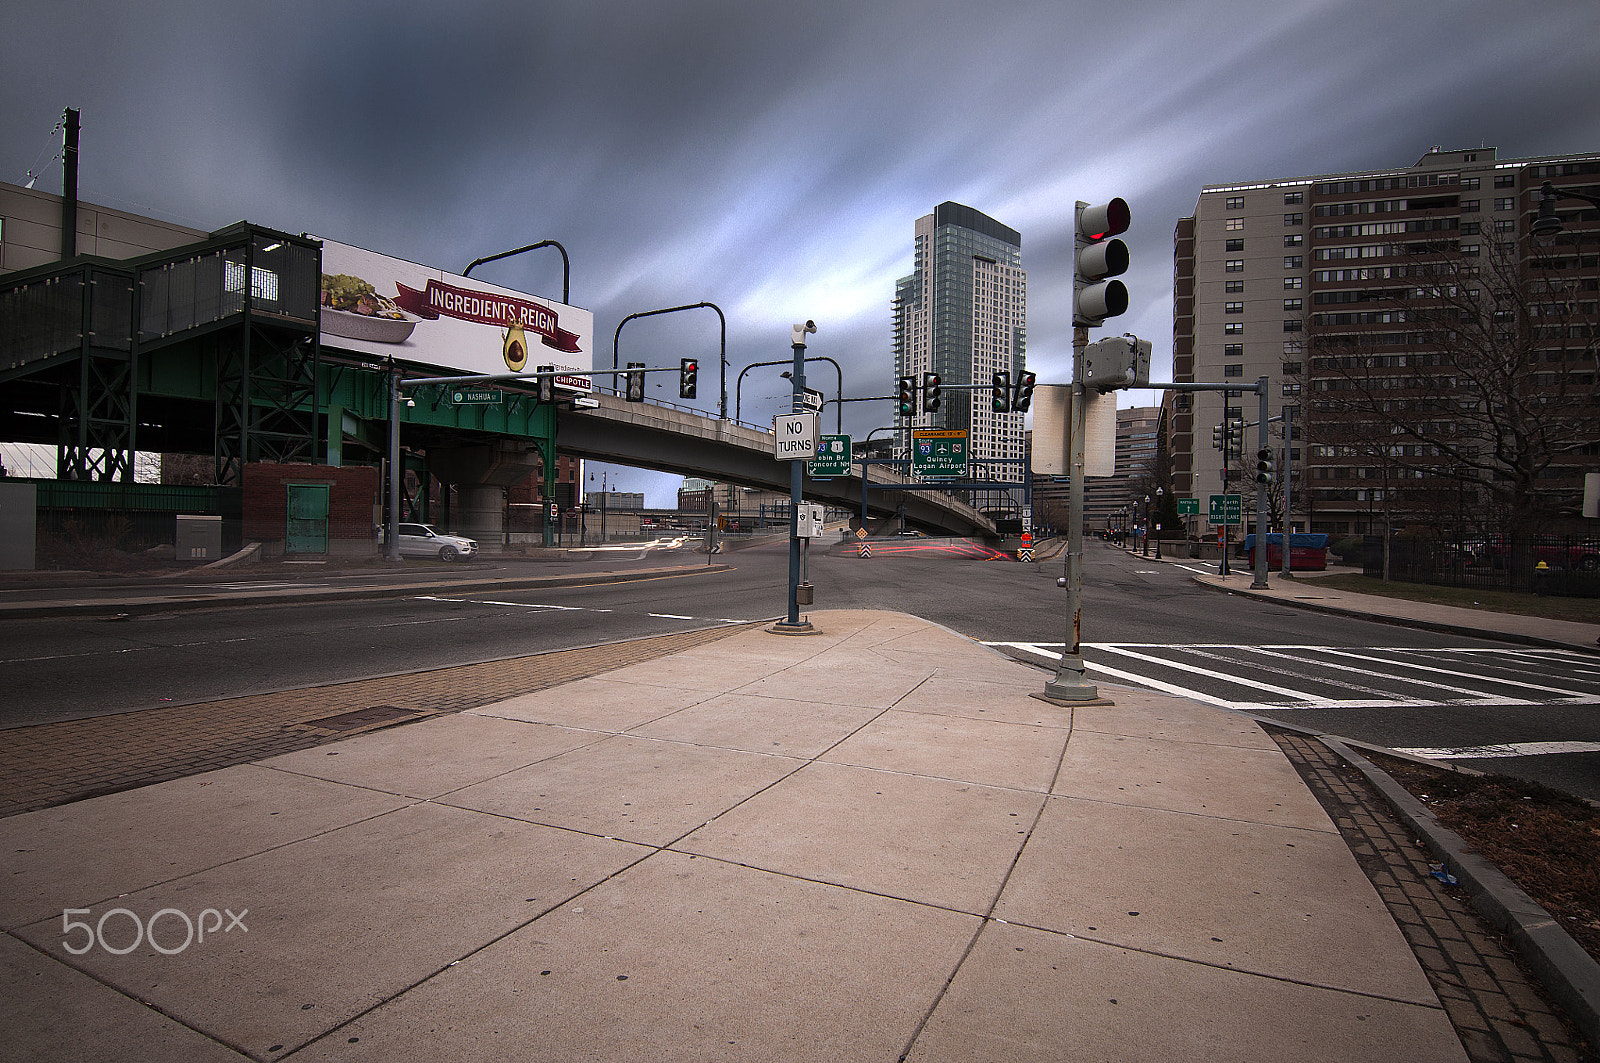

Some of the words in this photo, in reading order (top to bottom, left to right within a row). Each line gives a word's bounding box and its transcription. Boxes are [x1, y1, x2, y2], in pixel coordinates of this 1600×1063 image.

[430, 287, 516, 320] INGREDIENTS
[520, 306, 555, 334] REIGN
[556, 375, 590, 388] CHIPOTLE
[467, 393, 491, 401] NASHUA
[787, 421, 802, 435] NO
[778, 439, 812, 453] TURNS
[920, 445, 930, 453] 93
